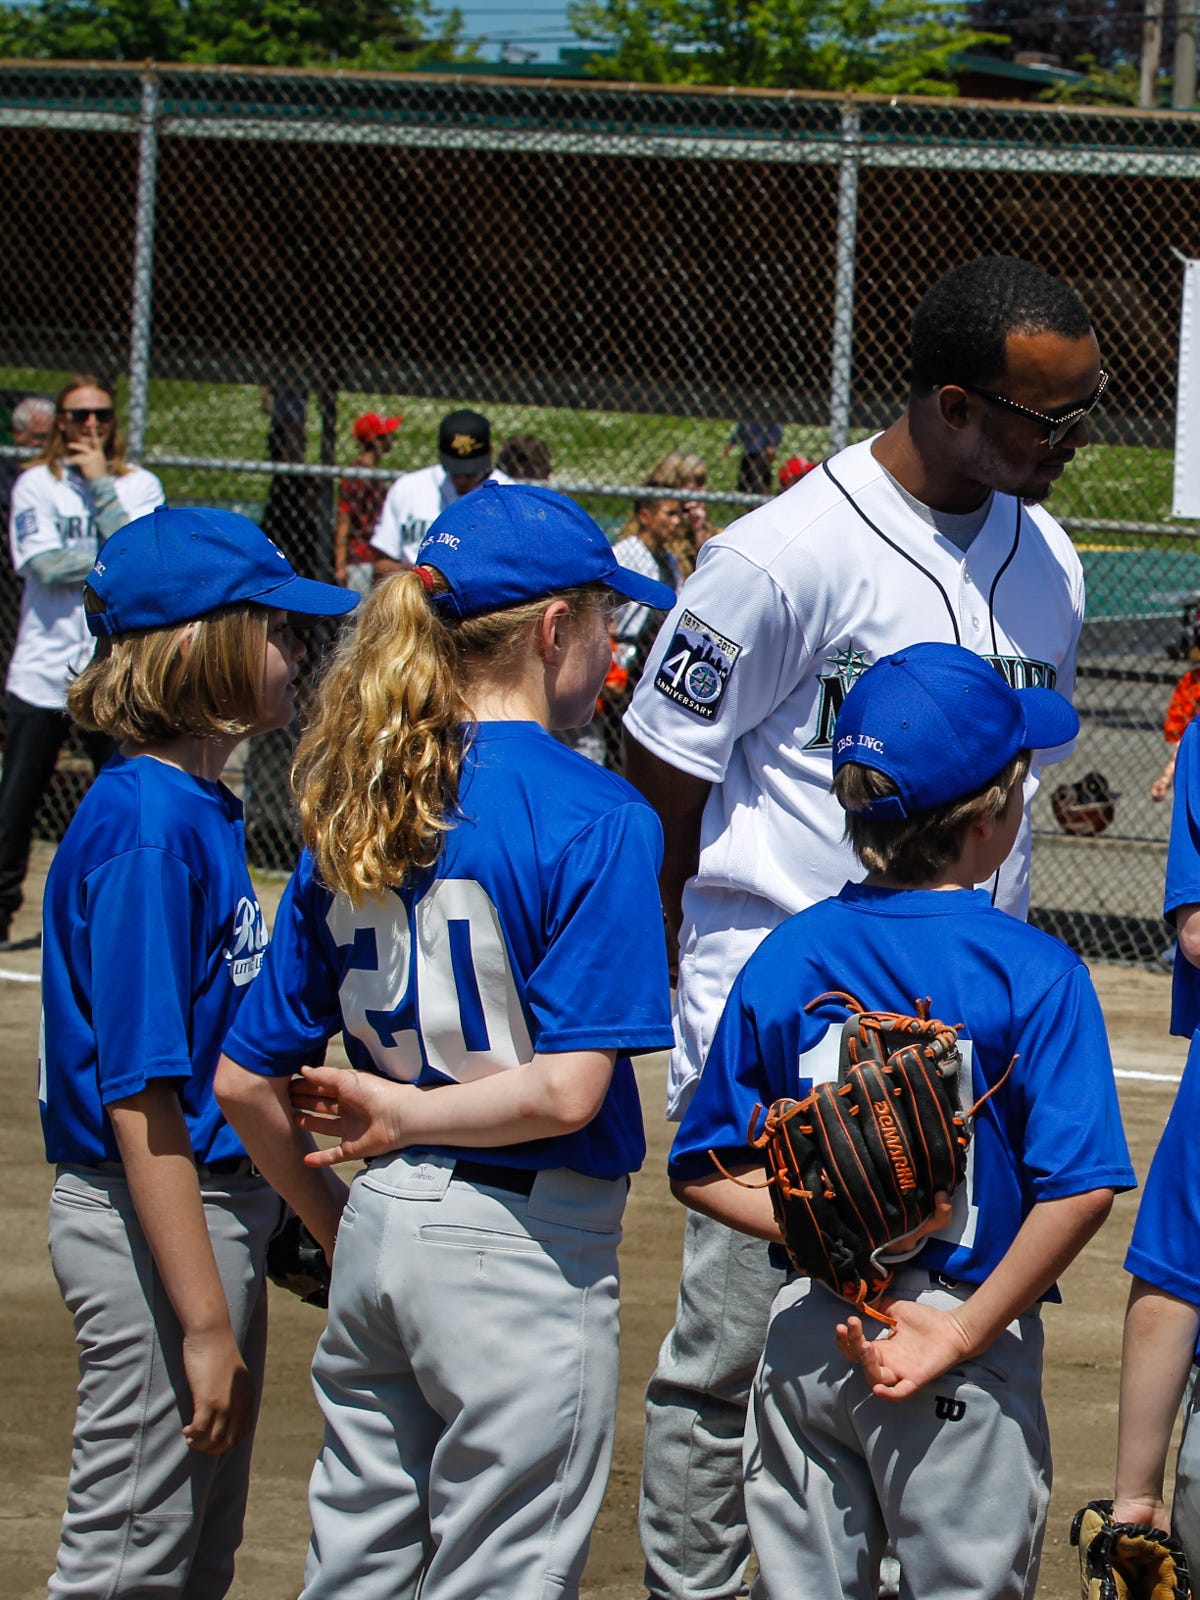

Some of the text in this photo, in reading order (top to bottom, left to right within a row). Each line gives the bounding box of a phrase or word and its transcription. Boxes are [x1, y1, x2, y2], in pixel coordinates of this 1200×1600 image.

[656, 677, 713, 717] ANNIVERSARY
[857, 734, 884, 755] INC.
[324, 878, 534, 1084] 20
